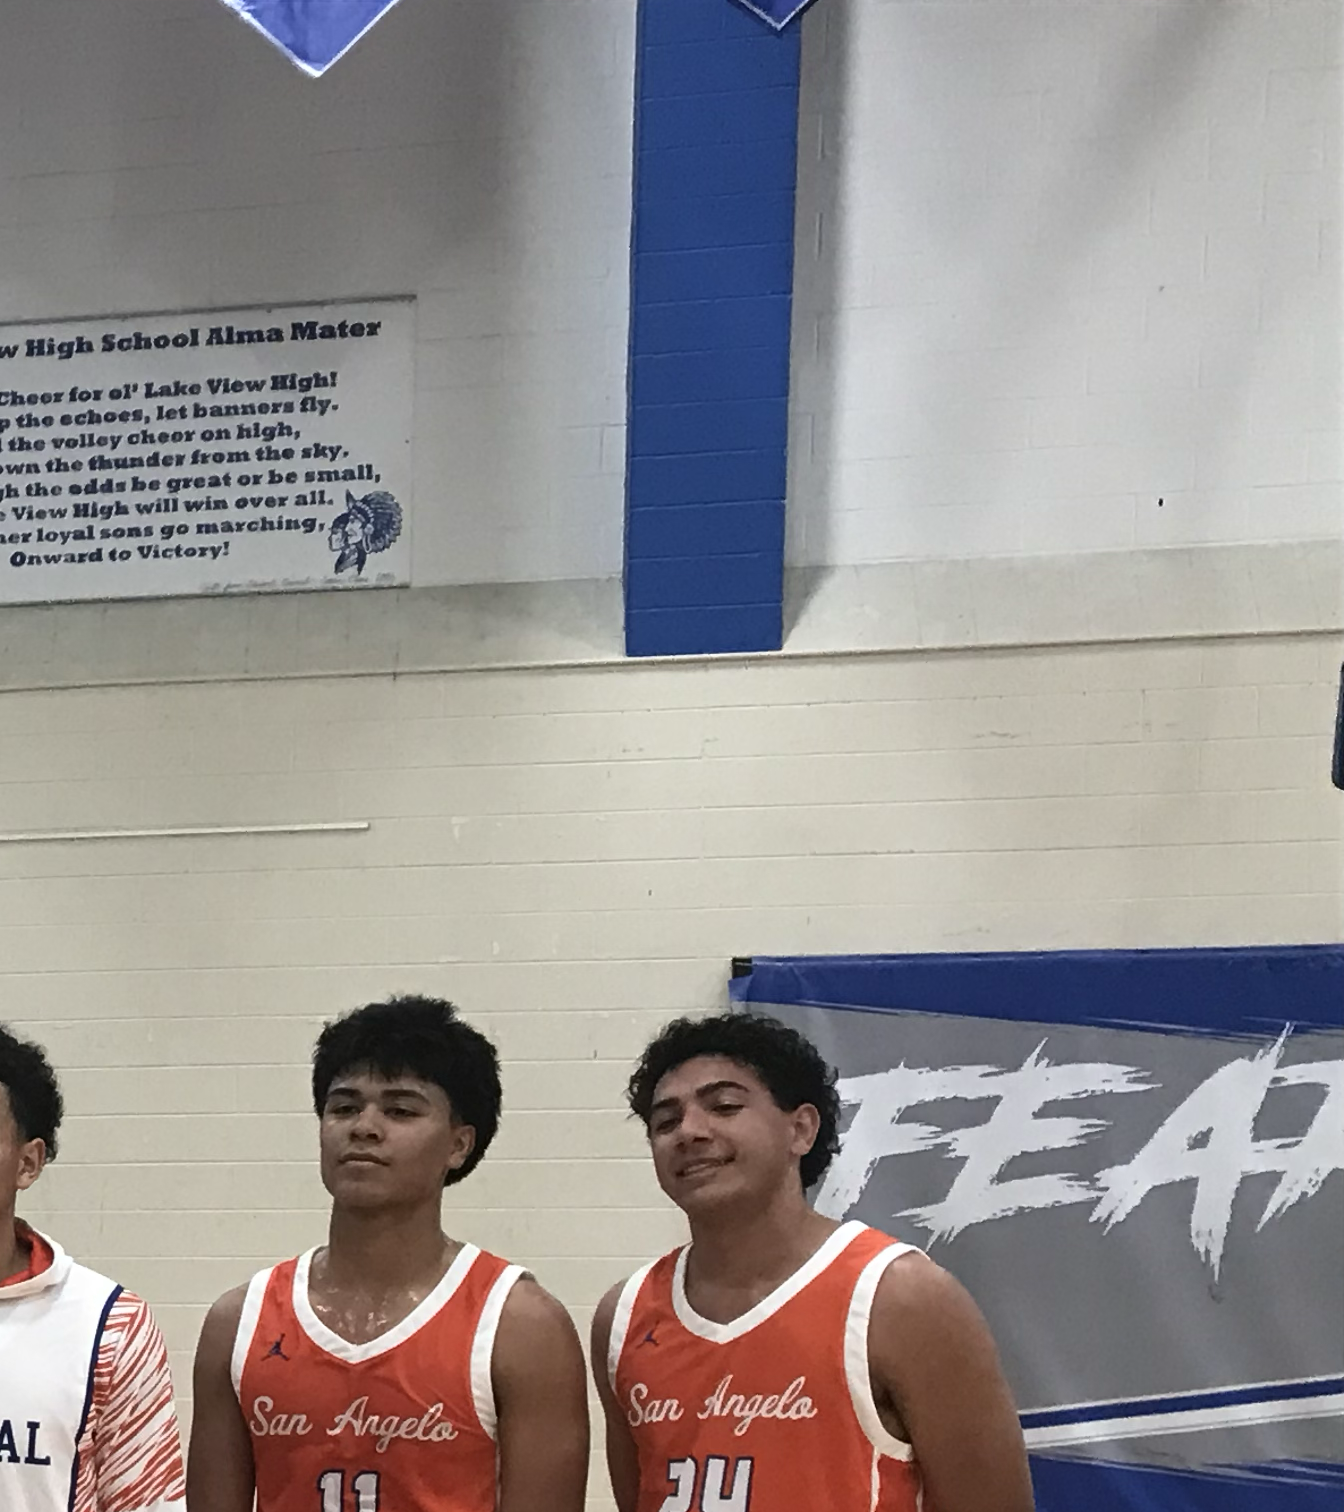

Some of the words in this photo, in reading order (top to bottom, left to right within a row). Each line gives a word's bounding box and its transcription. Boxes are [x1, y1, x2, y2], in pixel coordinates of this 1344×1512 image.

[25, 336, 94, 360] High
[101, 328, 200, 352] School
[205, 326, 284, 346] Alma
[290, 320, 381, 340] Mater
[69, 386, 103, 403] for
[144, 381, 201, 399] Lake
[206, 378, 266, 395] View
[270, 371, 337, 393] High!
[15, 413, 54, 429] the
[60, 409, 150, 426] echoes,
[156, 405, 188, 421] let
[193, 401, 294, 419] banners
[8, 436, 46, 452] the
[51, 433, 123, 451] volley
[127, 429, 196, 445] cheer
[200, 428, 231, 442] on
[236, 421, 300, 442] high,
[45, 457, 83, 473] the
[88, 449, 186, 471] thunder
[190, 449, 251, 465] from
[255, 445, 295, 462] the
[25, 482, 62, 497] the
[68, 478, 126, 495] odds
[131, 476, 161, 492] be
[166, 472, 231, 494] great
[237, 474, 263, 486] or
[267, 469, 298, 485] be
[305, 464, 380, 483] small,
[11, 505, 67, 521] View
[72, 501, 129, 520] High
[135, 498, 180, 514] will
[182, 496, 228, 512] win
[235, 496, 288, 509] over
[36, 525, 95, 545] loyal
[100, 526, 153, 540] sons
[160, 524, 189, 540] go
[10, 548, 103, 567] Onward
[108, 548, 132, 562] to
[137, 541, 229, 560] Victory!
[628, 1383, 684, 1427] San
[697, 1374, 818, 1436] Angelo
[250, 1396, 313, 1436] San
[326, 1395, 459, 1453] Angelo
